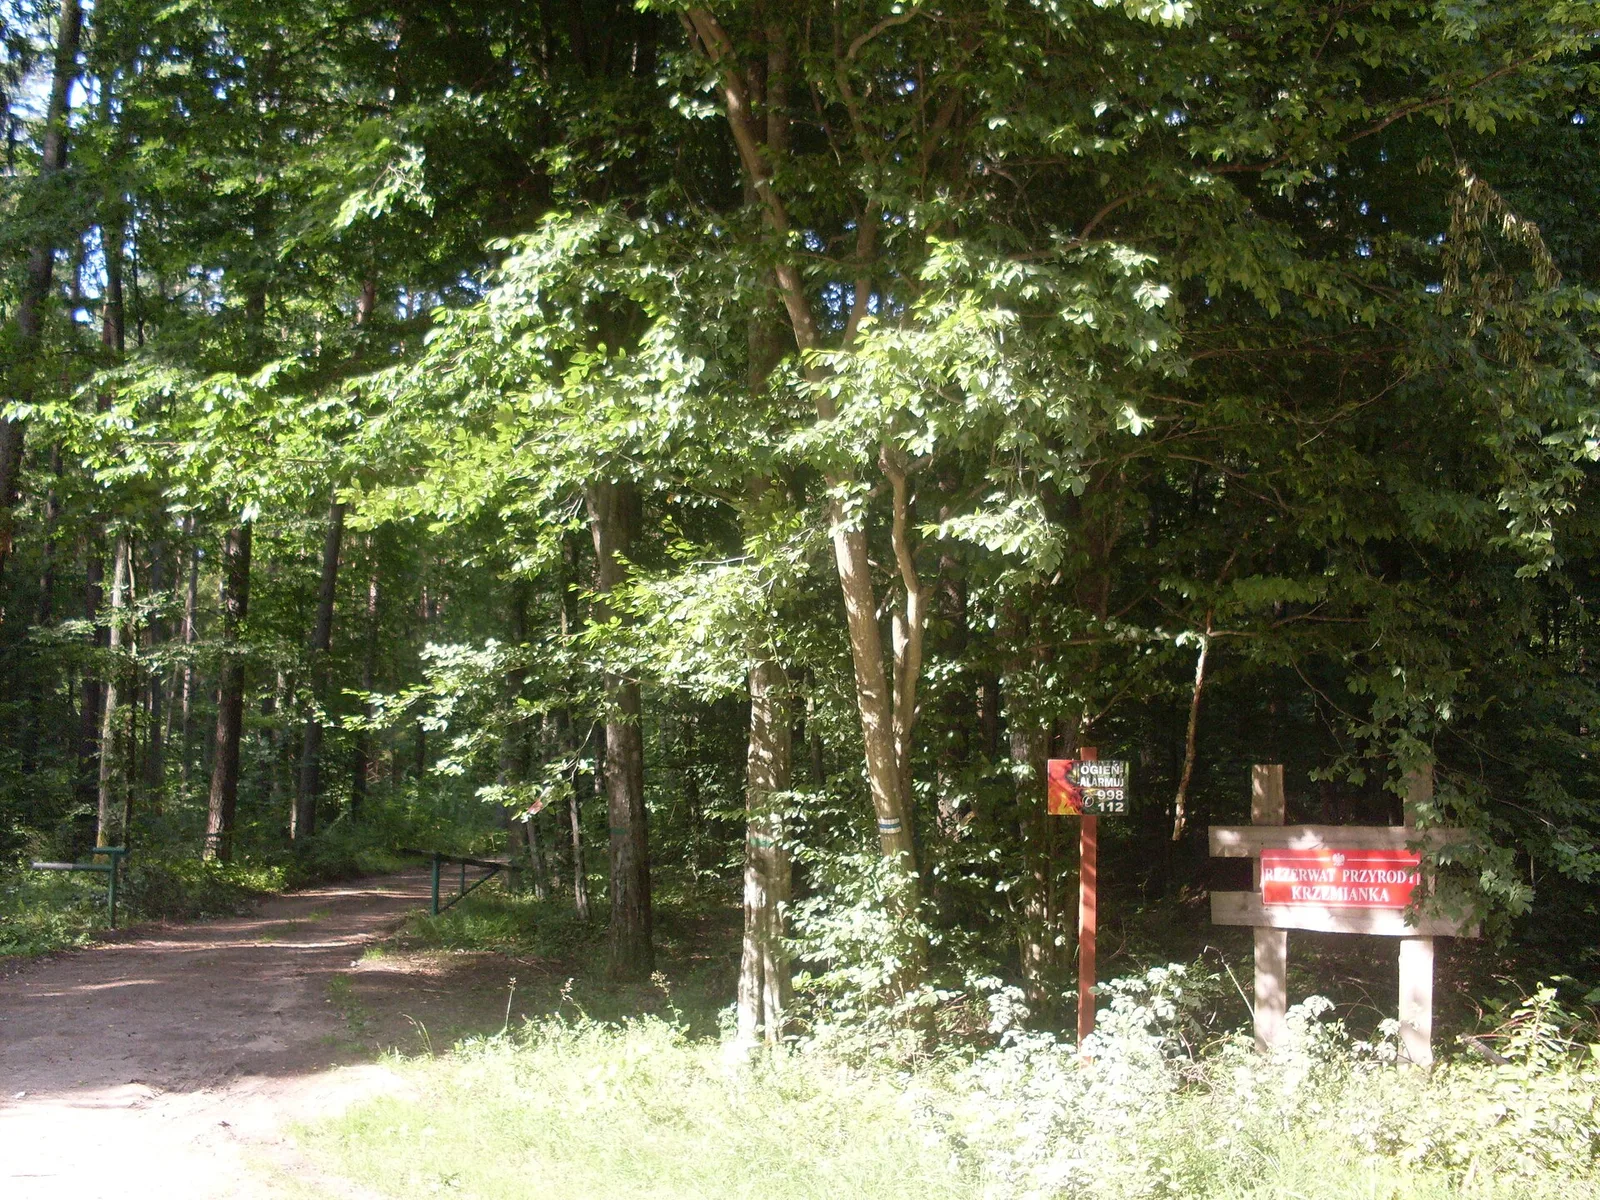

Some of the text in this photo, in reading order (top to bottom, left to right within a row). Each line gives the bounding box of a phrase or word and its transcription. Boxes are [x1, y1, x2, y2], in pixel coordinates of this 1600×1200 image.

[1080, 777, 1124, 787] ALARMUJ
[1097, 790, 1124, 800] 998
[1097, 802, 1124, 812] 112
[1264, 867, 1337, 882] REZERWAT
[1291, 885, 1389, 902] KRZEMIANKA
